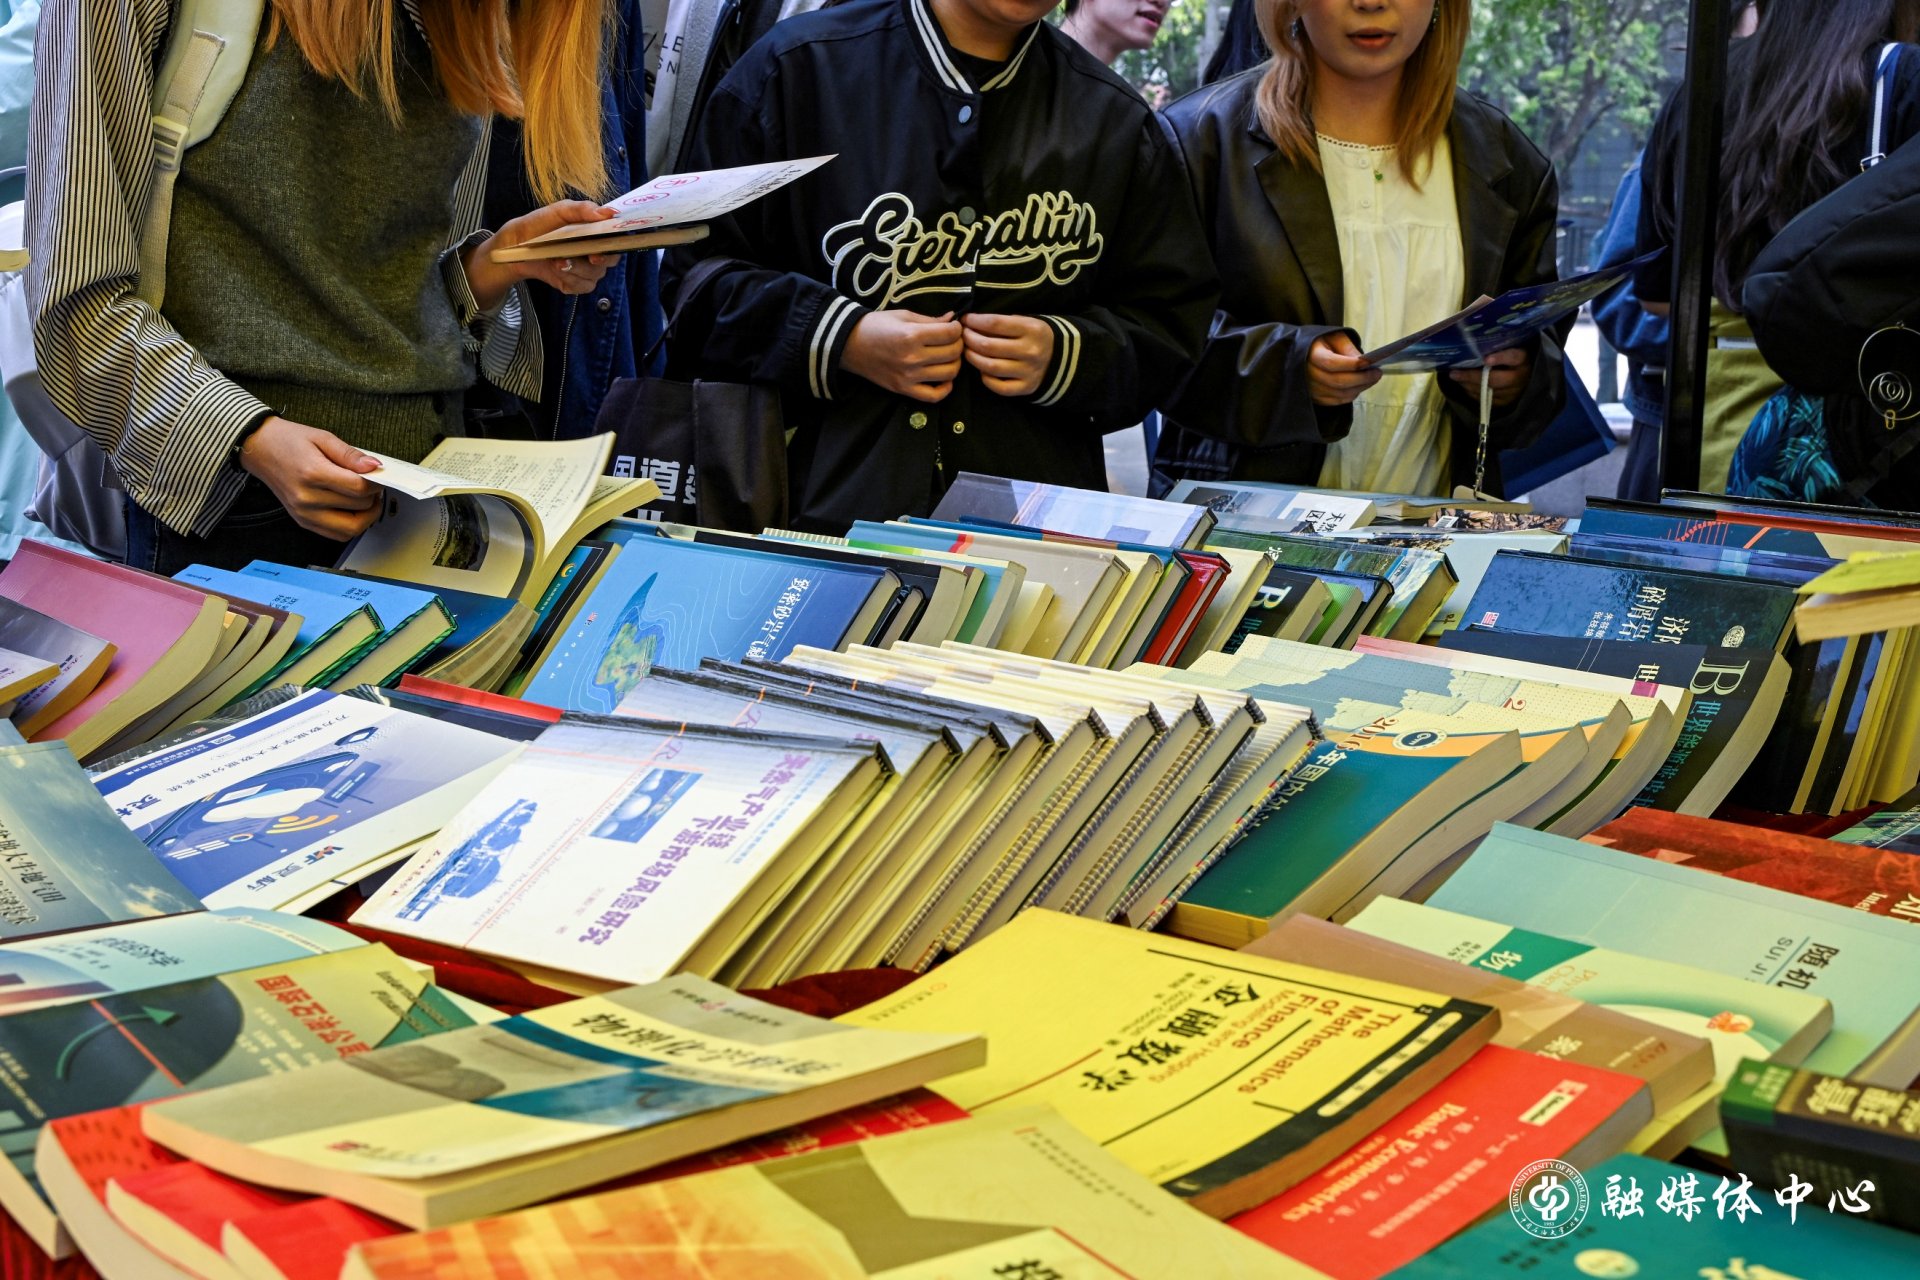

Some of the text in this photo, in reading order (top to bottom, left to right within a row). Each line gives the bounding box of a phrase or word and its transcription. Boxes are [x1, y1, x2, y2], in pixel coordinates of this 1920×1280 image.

[823, 190, 1103, 310] Eternality
[746, 577, 810, 659] 致密砂岩气藏
[1617, 585, 1668, 642] 碎屑岩
[1689, 658, 1751, 696] B
[701, 752, 811, 850] 天然气产业链
[578, 815, 718, 945] 下游市场风险研究
[1485, 950, 1523, 972] 物
[1764, 937, 1793, 966] SUI
[1776, 942, 1840, 991] 随机
[255, 974, 373, 1059] 国际石油公司
[1080, 982, 1261, 1092] 金融数学
[1231, 993, 1319, 1050] Finance
[1322, 999, 1341, 1017] of
[1369, 1012, 1402, 1040] The
[1236, 1005, 1375, 1095] Mathematics
[1280, 1137, 1418, 1222] Econometrics
